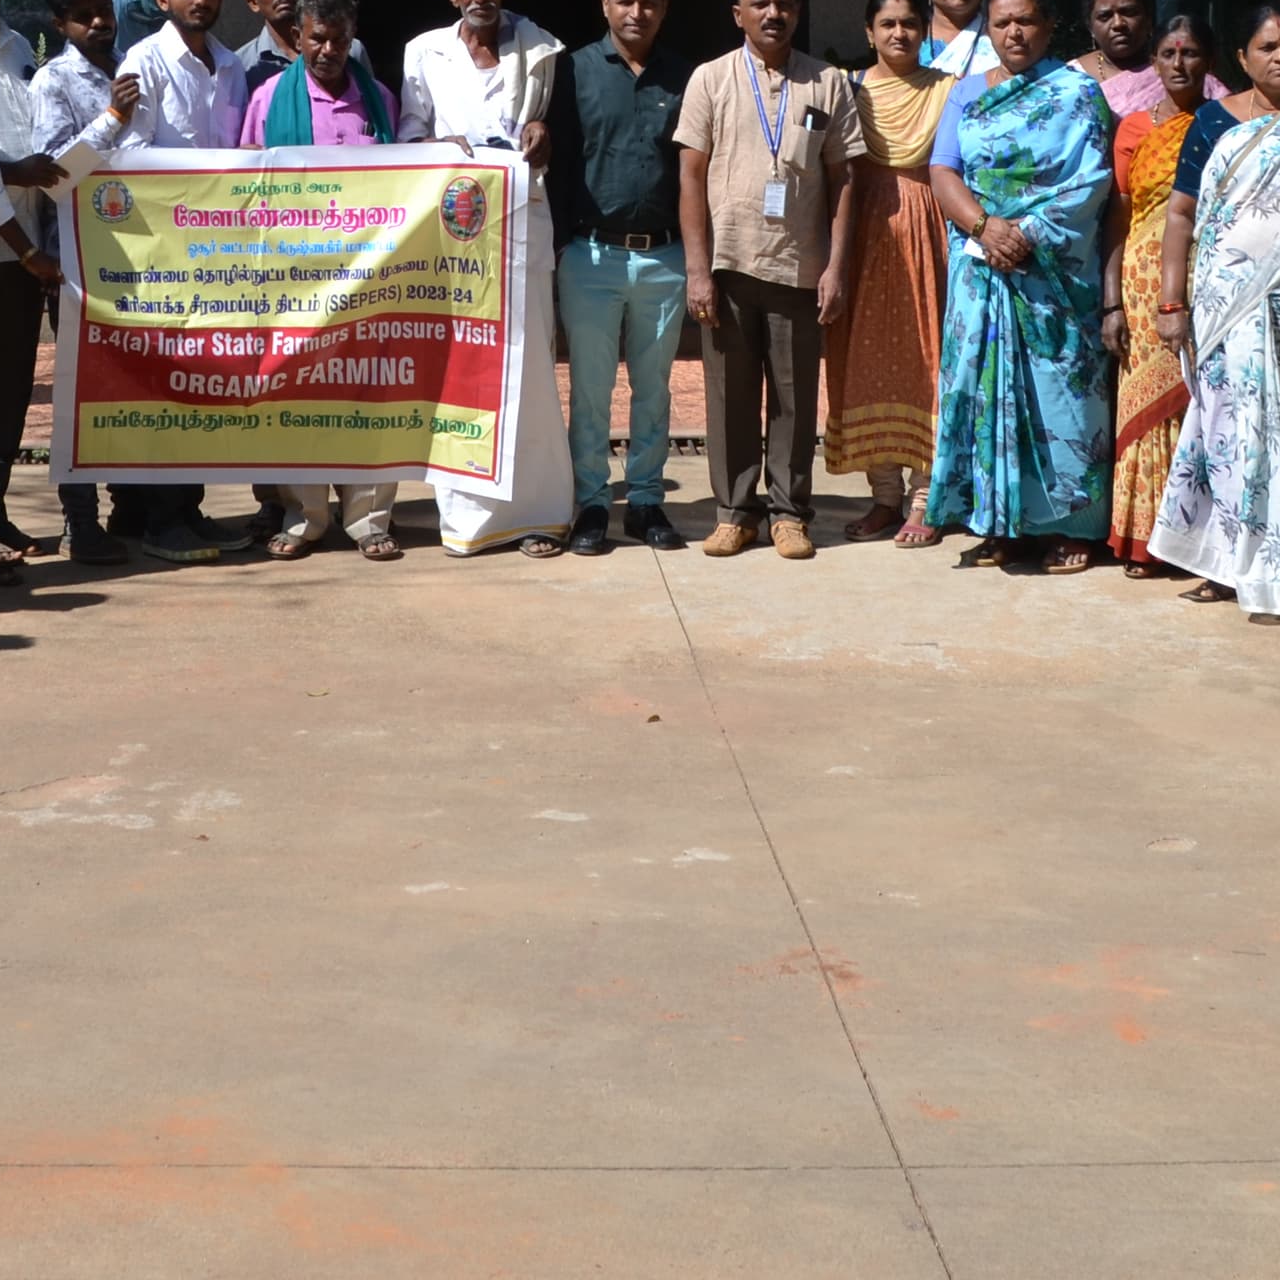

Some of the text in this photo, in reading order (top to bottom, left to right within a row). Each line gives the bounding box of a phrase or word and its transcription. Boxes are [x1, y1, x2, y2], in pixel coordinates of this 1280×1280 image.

[306, 183, 342, 194] அரசு
[173, 200, 407, 233] வேளாண்மைத்துறை
[99, 265, 189, 284] வேளாண்மை
[434, 256, 485, 280] (ATMA)
[325, 284, 402, 316] (SSEPERS)
[406, 285, 473, 304] 2023-24
[88, 319, 497, 357] B.4(a) Inter State Farmers Exposure Visit
[169, 356, 415, 398] ORGANIC FARMING
[429, 415, 482, 440] துறை
